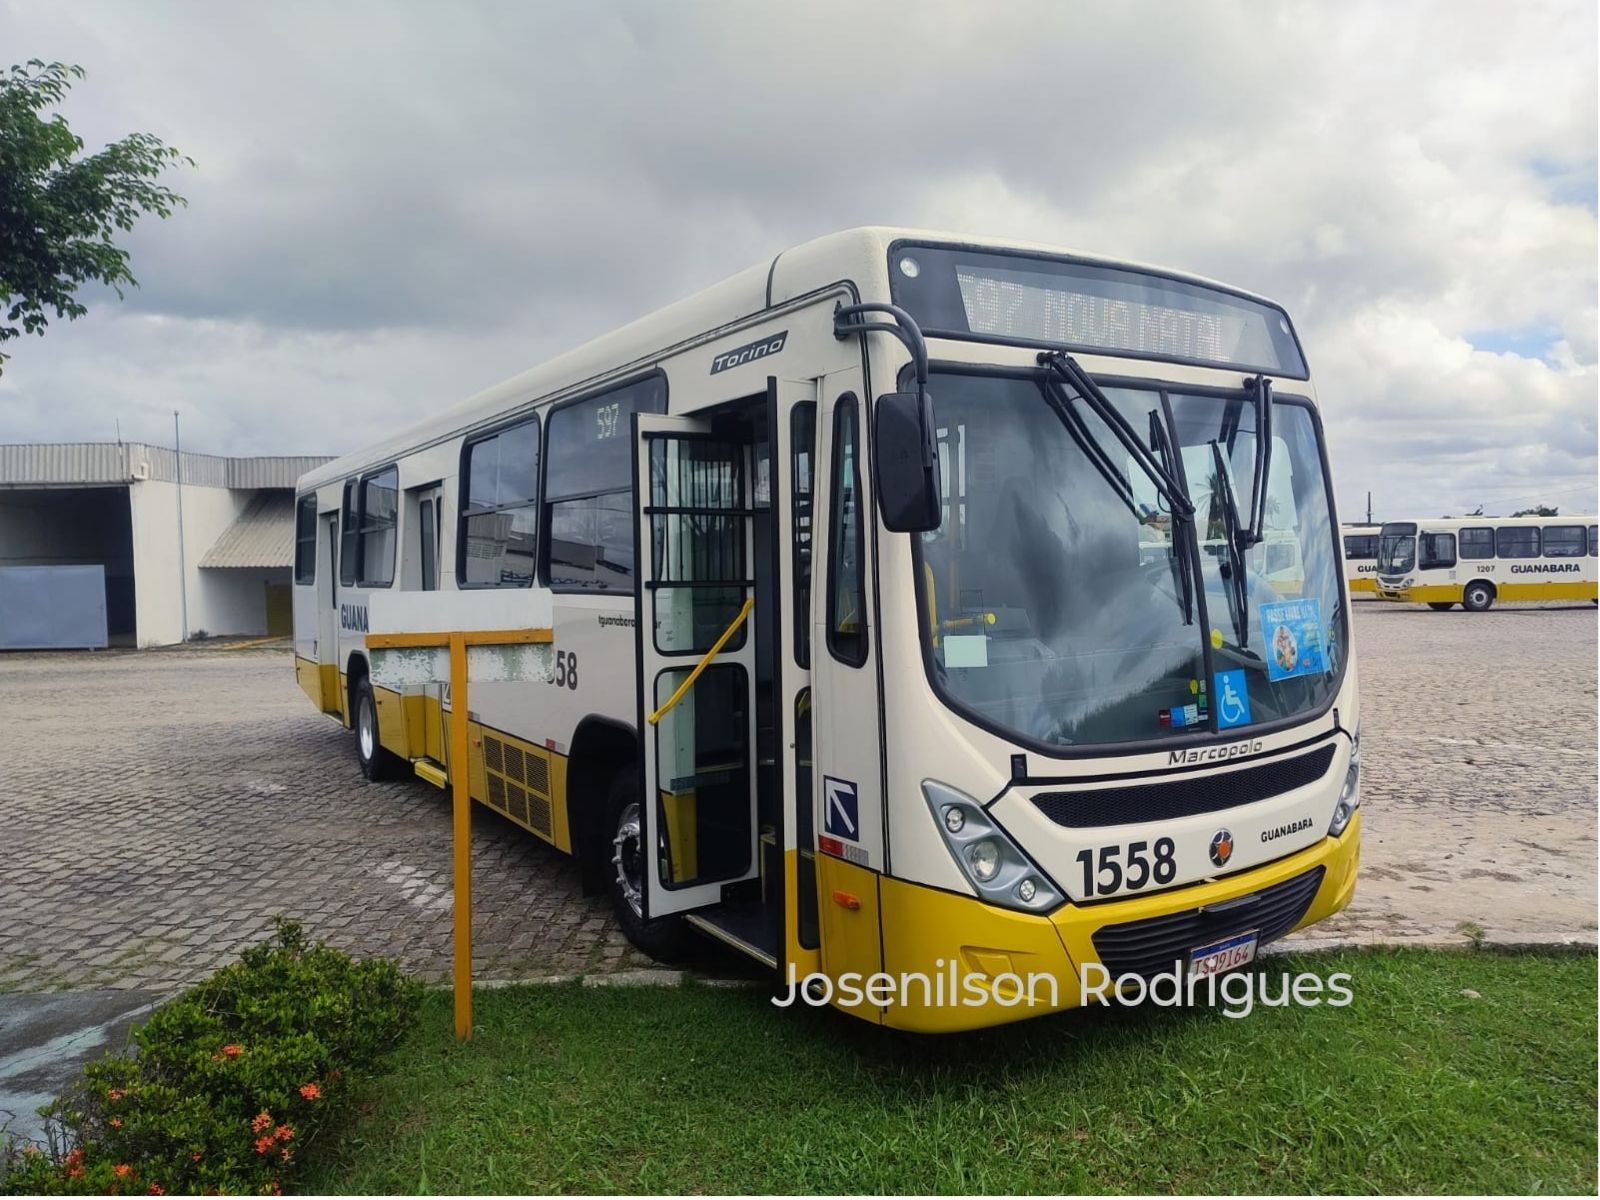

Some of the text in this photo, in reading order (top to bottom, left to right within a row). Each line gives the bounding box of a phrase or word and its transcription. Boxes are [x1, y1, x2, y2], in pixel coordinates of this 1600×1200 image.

[1044, 288, 1129, 350] NOVA
[1139, 303, 1231, 362] NATAL
[714, 339, 783, 371] Torino
[596, 402, 619, 440] 597
[1357, 565, 1377, 573] GUA
[1477, 565, 1496, 573] 1207
[1510, 563, 1581, 574] GUANABARA
[341, 603, 369, 633] GUANA
[546, 650, 578, 691] 58
[1167, 739, 1263, 766] Marcopolo
[1260, 817, 1314, 843] GUANABARA
[1075, 836, 1177, 898] 1558
